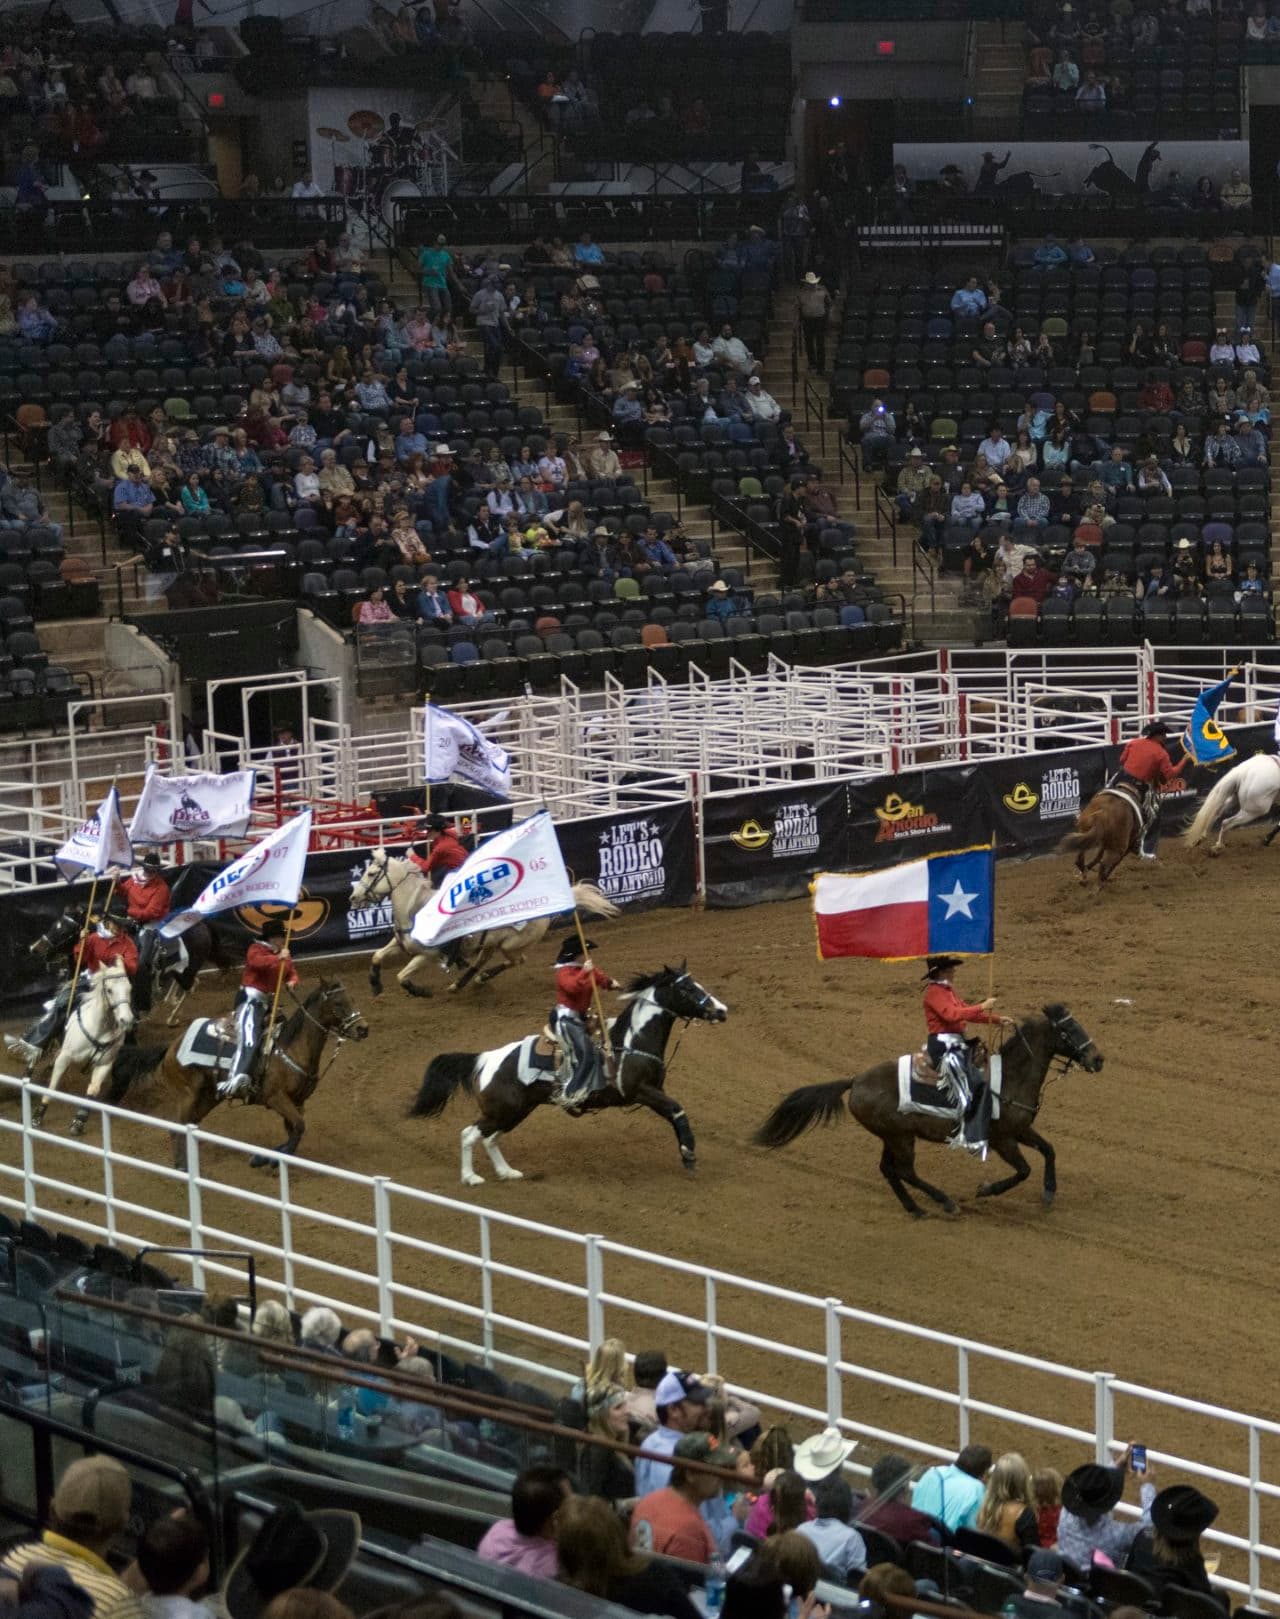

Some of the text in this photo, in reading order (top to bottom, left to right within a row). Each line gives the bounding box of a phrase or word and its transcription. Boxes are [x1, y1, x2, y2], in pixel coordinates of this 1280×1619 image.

[1049, 767, 1072, 782] LET'S
[1041, 779, 1080, 802] RODEO
[783, 803, 809, 819] LET'S
[611, 821, 649, 846] LET'S
[774, 816, 817, 838] RODEO
[894, 830, 909, 839] Stock
[910, 827, 926, 836] Show
[931, 823, 952, 832] Rodeo
[772, 834, 820, 850] SAN ANTONIO
[273, 847, 289, 859] 07
[598, 838, 664, 878] RODEO
[529, 857, 547, 873] 05
[598, 867, 666, 895] SAN ANTONIO
[347, 908, 374, 928] SAN
